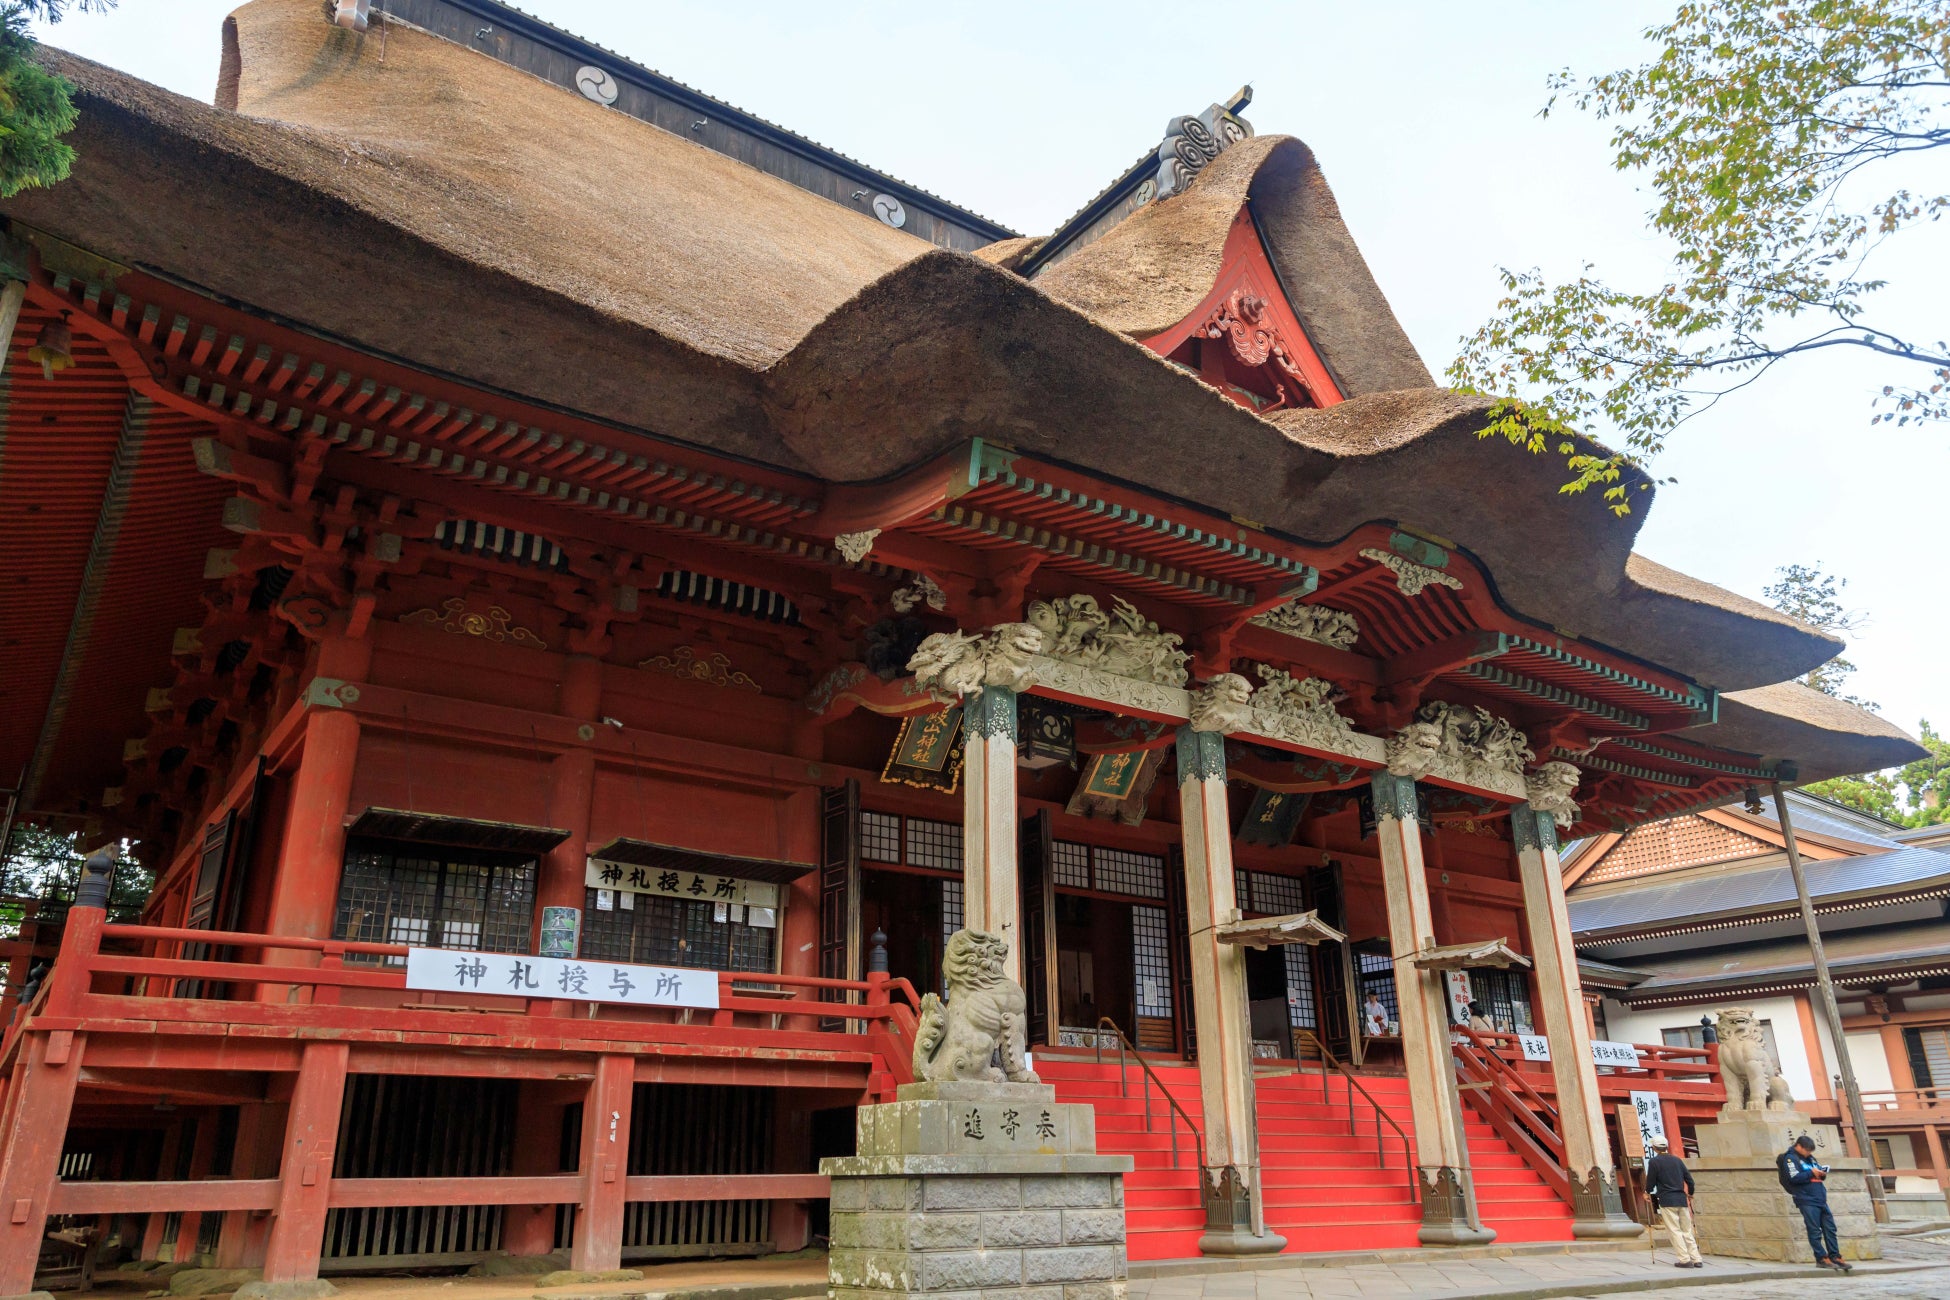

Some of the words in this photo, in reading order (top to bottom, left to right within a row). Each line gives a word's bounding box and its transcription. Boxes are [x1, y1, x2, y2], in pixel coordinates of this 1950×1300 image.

[1103, 752, 1131, 787] 神社
[599, 863, 737, 900] 神札授与所
[454, 956, 683, 1001] 神札授与所
[1525, 1039, 1547, 1056] 末社
[1636, 1096, 1655, 1160] 御朱印
